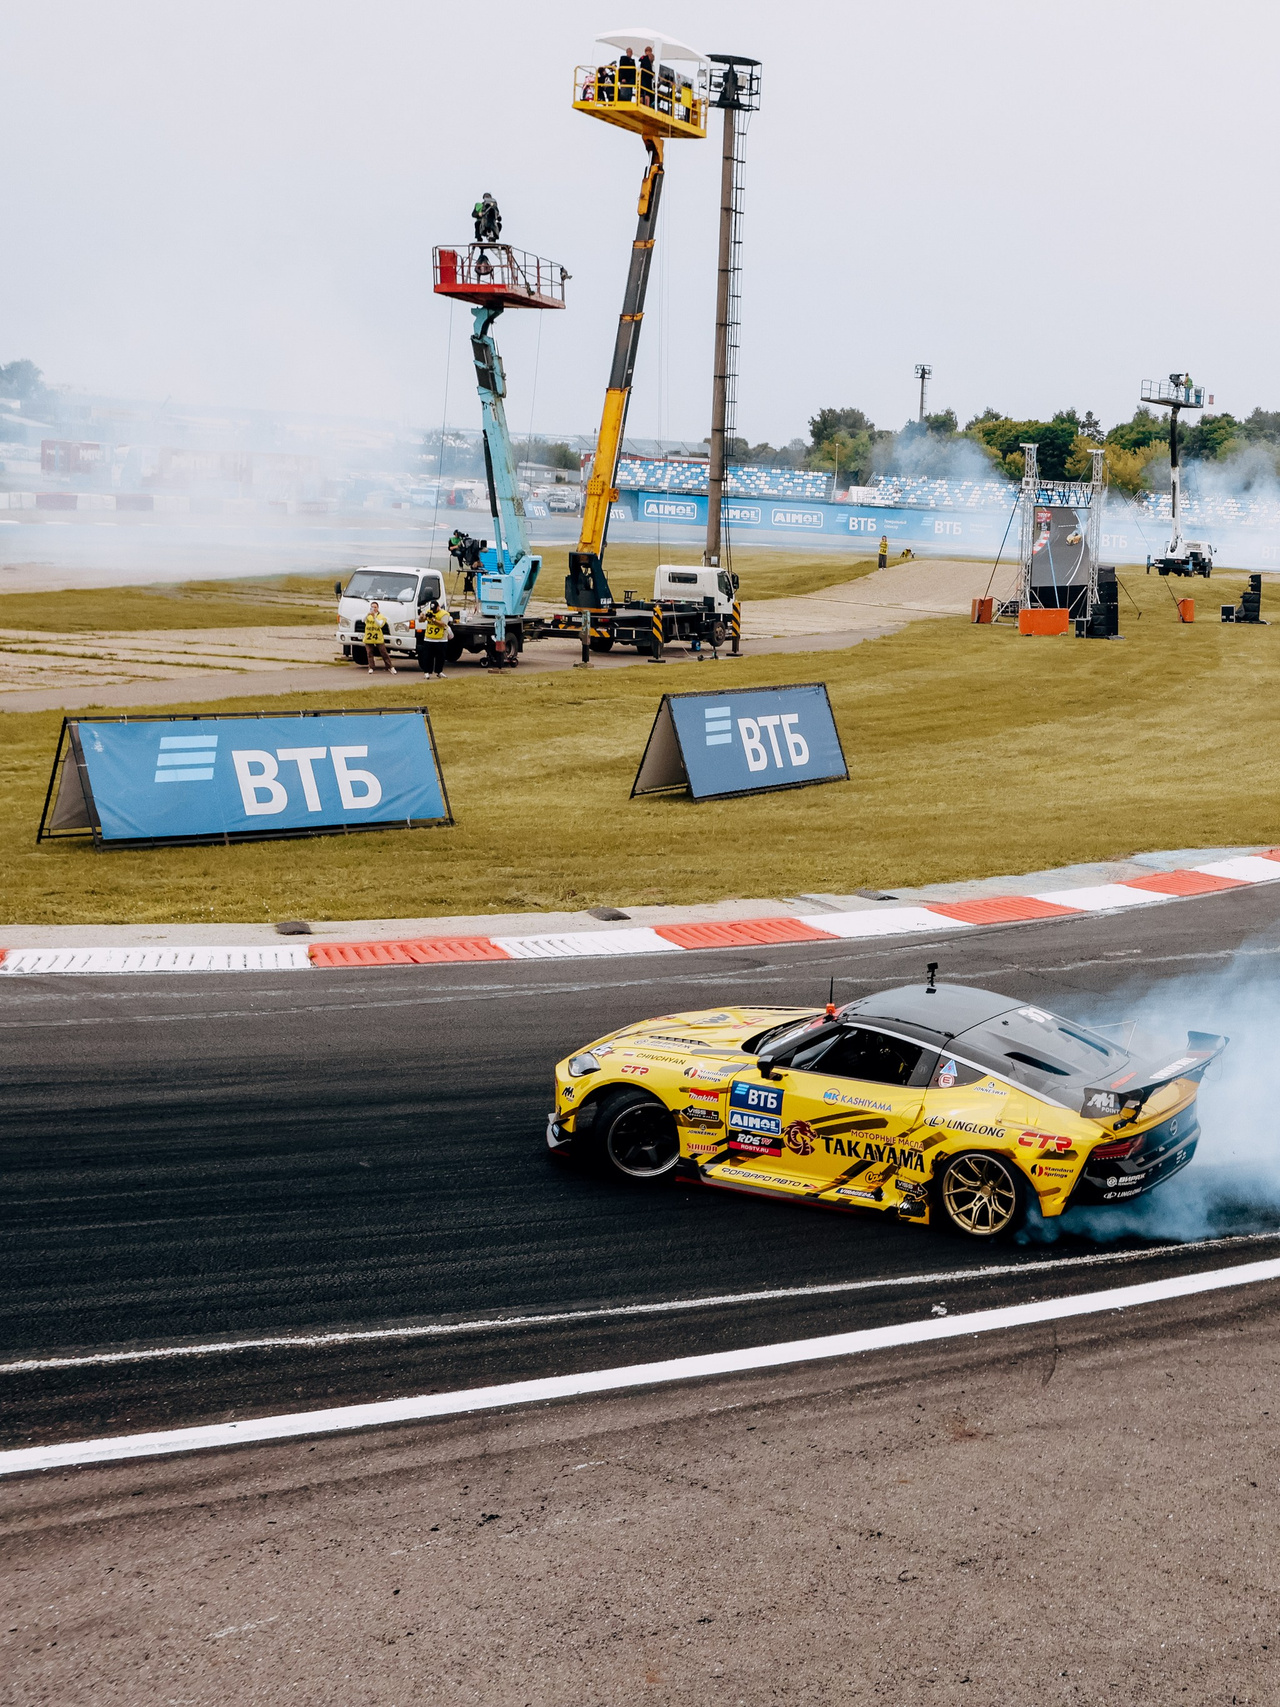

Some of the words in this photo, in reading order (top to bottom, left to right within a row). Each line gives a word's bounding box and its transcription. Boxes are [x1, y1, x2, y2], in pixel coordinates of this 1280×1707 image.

[532, 505, 547, 516] ВТБ
[646, 502, 694, 517] AIMOL
[774, 512, 820, 524] AIMOL
[849, 516, 877, 531] ВТБ
[934, 520, 962, 535] ВТБ
[1100, 534, 1128, 549] ВТБ
[366, 632, 379, 640] 24
[427, 627, 440, 635] 59
[737, 713, 810, 772] ВТБ
[231, 745, 383, 816] ВТБ
[636, 1052, 687, 1065] CHIVCHYAN
[748, 1088, 778, 1109] ВТБ
[840, 1094, 892, 1112] KASHIYAMA
[1101, 1106, 1120, 1115] POINT
[731, 1113, 778, 1131] AIMOL
[946, 1120, 1006, 1138] LINGLONG
[851, 1130, 897, 1141] МОТОРНЫЕ
[898, 1138, 924, 1150] МАСЛА
[821, 1136, 926, 1173] TAKAYAMA
[721, 1167, 772, 1181] ФОРВАРД
[772, 1178, 801, 1187] АВТО
